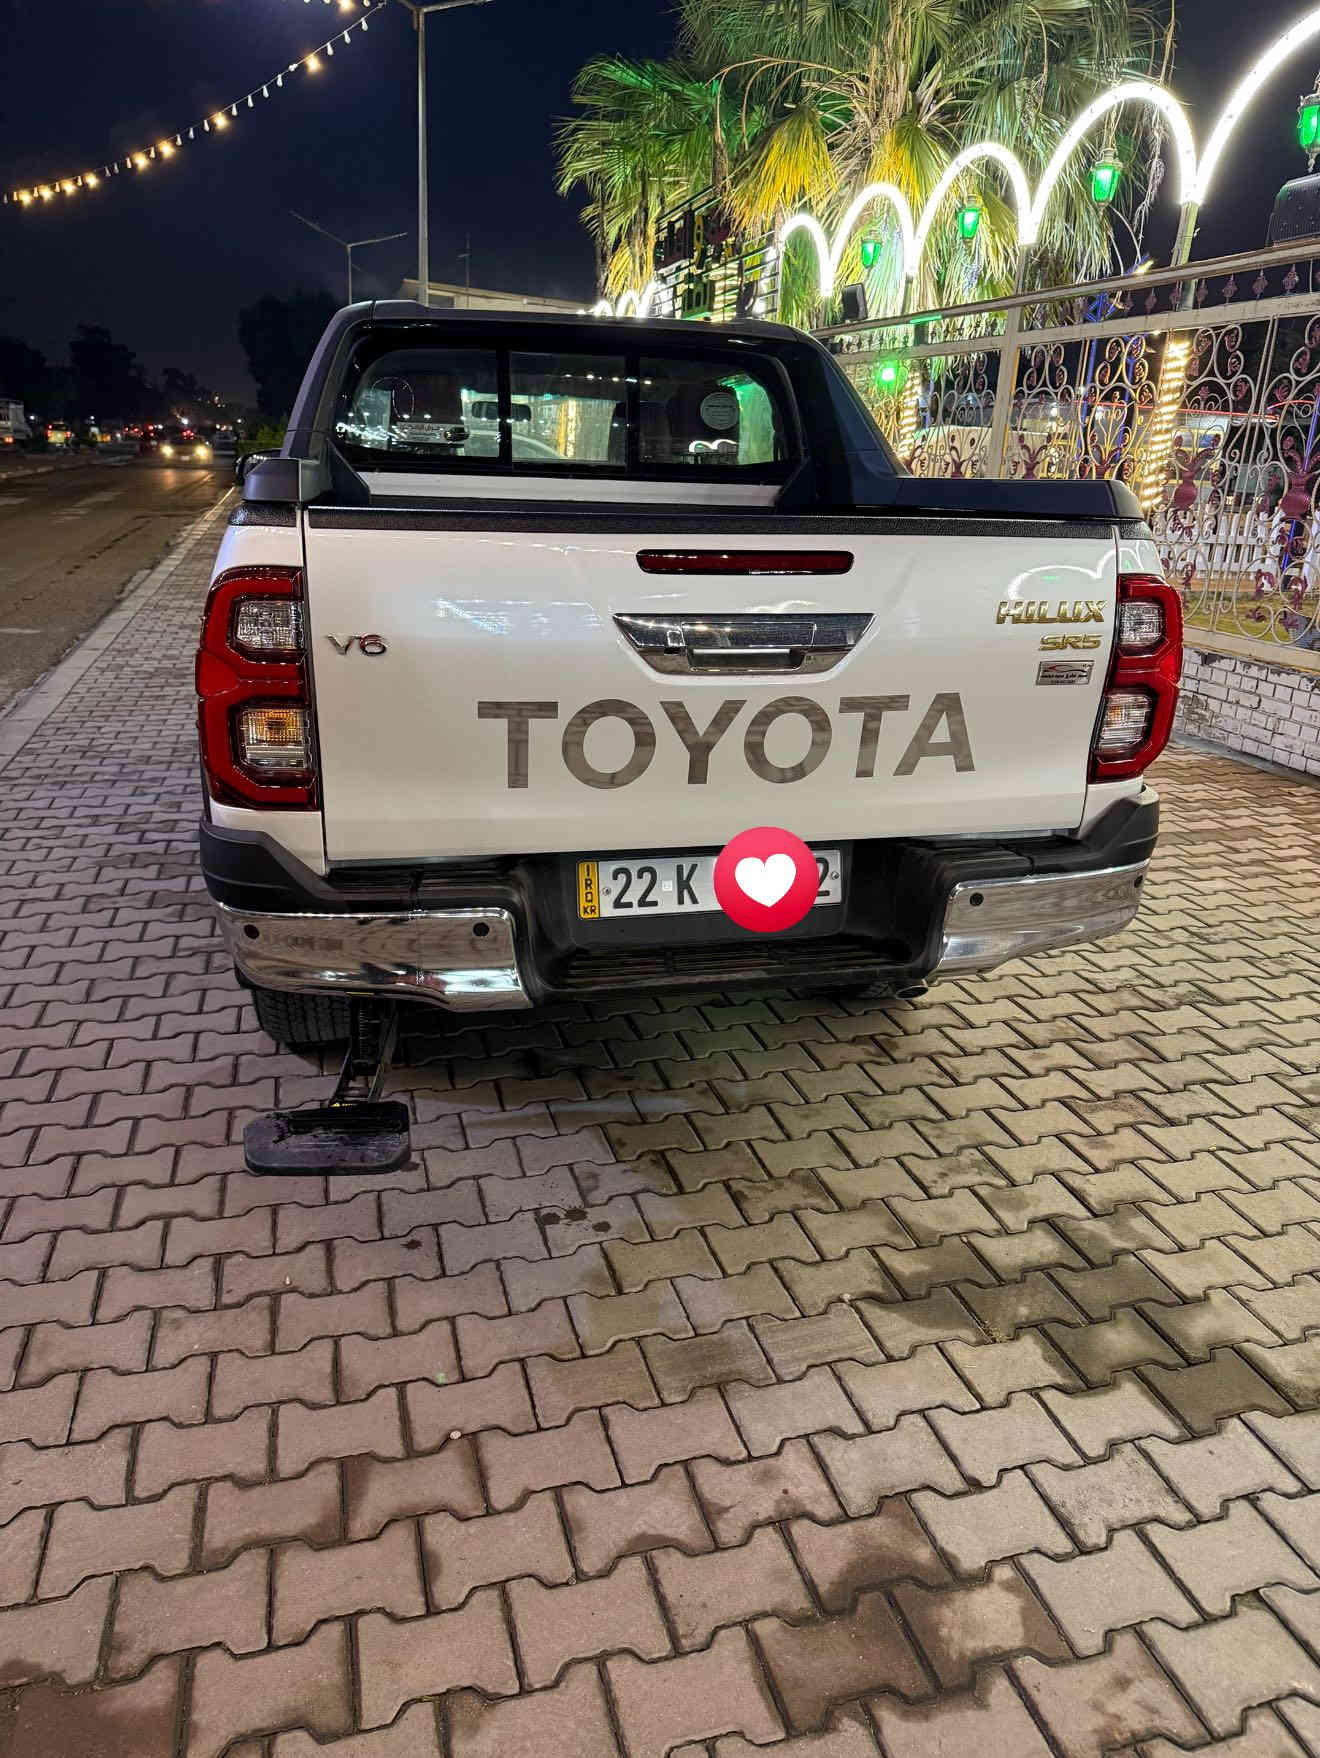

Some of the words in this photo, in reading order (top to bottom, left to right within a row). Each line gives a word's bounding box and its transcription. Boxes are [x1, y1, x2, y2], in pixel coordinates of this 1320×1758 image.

[995, 600, 1106, 624] HILUX
[324, 633, 387, 656] V6
[1039, 634, 1102, 651] SR5
[478, 692, 976, 789] TOYOTA
[612, 866, 659, 909] 22
[676, 863, 700, 905] K
[583, 904, 597, 915] KR
